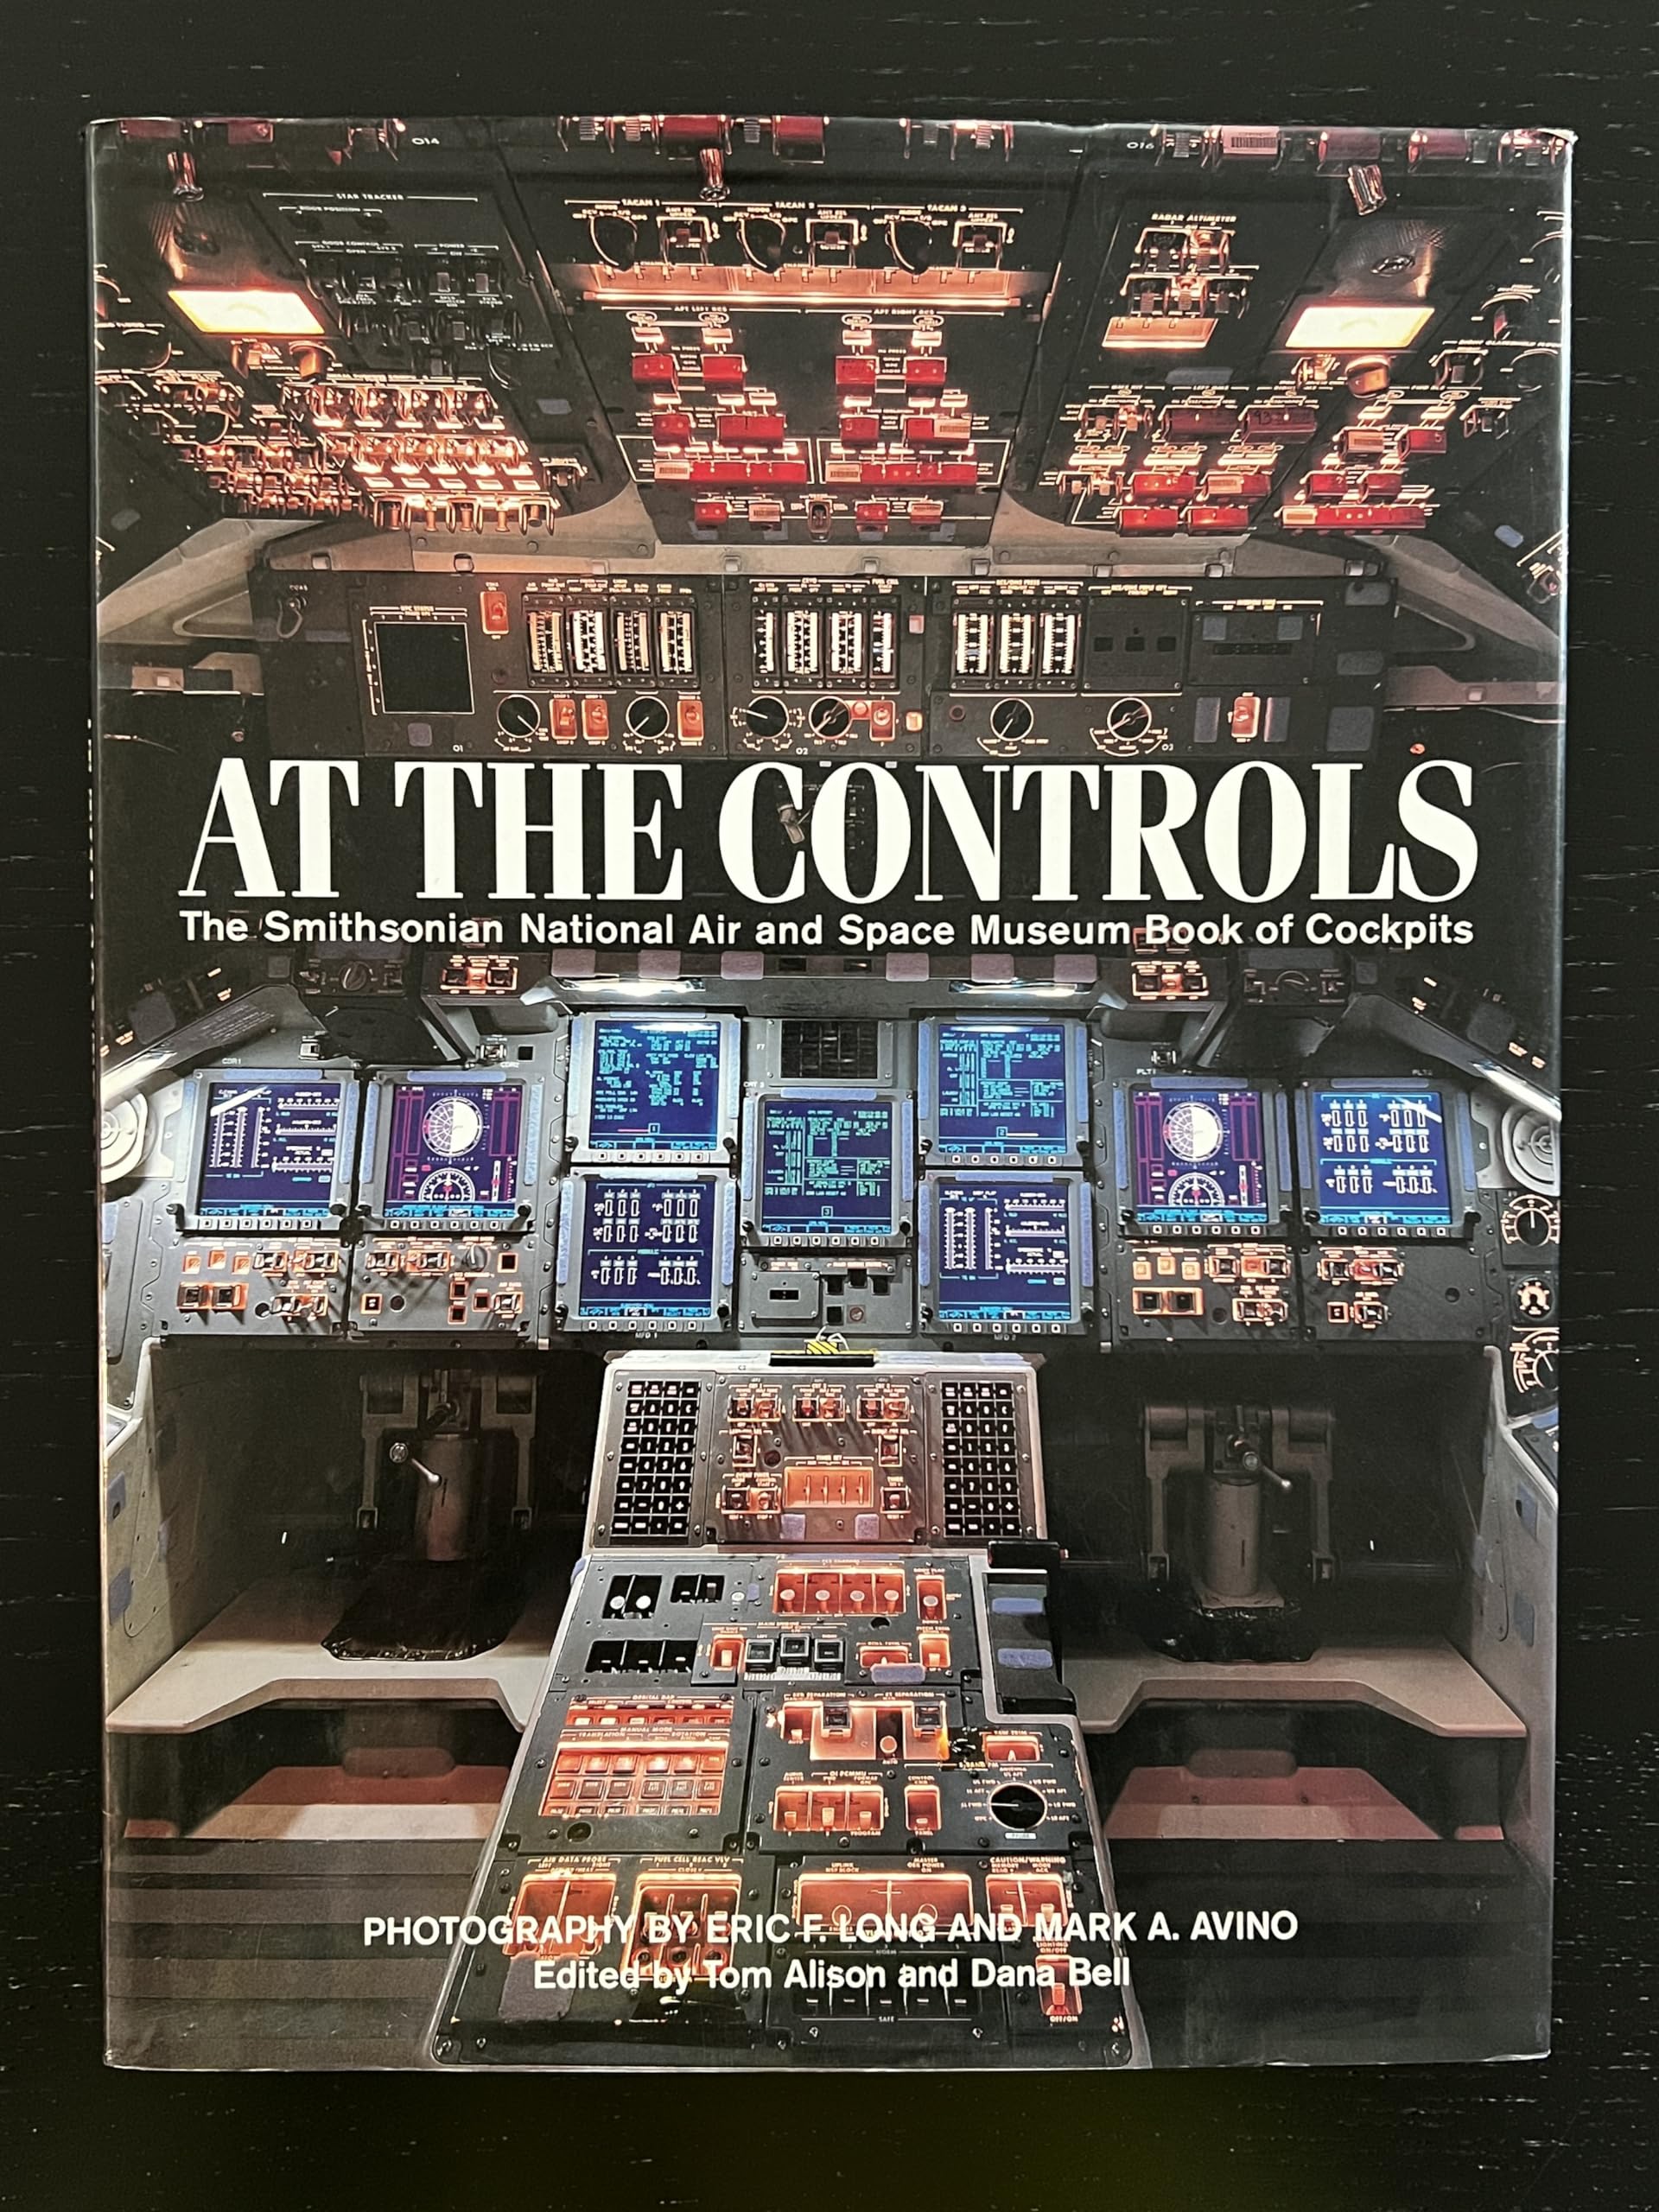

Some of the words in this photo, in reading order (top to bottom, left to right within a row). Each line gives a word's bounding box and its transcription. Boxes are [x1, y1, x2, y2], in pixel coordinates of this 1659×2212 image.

[1151, 213, 1185, 222] RADAR
[1186, 213, 1237, 223] ALTIMETER
[178, 757, 359, 899] AT
[394, 760, 683, 901] THE
[718, 760, 1478, 905] CONTROLS
[179, 910, 248, 943] The
[264, 911, 504, 945] Smithsonian
[520, 912, 673, 945] National
[689, 914, 741, 944] Air
[754, 914, 823, 946] and
[838, 914, 956, 955] Space
[970, 915, 1131, 947] Museum
[1144, 914, 1244, 946] Book
[1255, 913, 1294, 945] of
[1305, 912, 1474, 954] Cockpits
[989, 1856, 1067, 1865] CAUTION/WARNING
[364, 1916, 632, 1947] PHOTOGRAPHY
[648, 1915, 693, 1944] BY
[706, 1914, 791, 1944] ERIC
[803, 1913, 827, 1942] F.
[838, 1912, 937, 1942] LONG
[948, 1912, 1023, 1942] AND
[1035, 1911, 1138, 1942] MARK
[1147, 1911, 1179, 1941] A.
[1191, 1910, 1299, 1941] AVINO
[533, 1959, 641, 1990] Edited
[653, 1960, 692, 1998] by
[702, 1959, 772, 1988] Tom
[784, 1958, 887, 1988] Alison
[898, 1958, 958, 1987] and
[972, 1958, 1056, 1987] Dana
[1069, 1955, 1129, 1986] Bell
